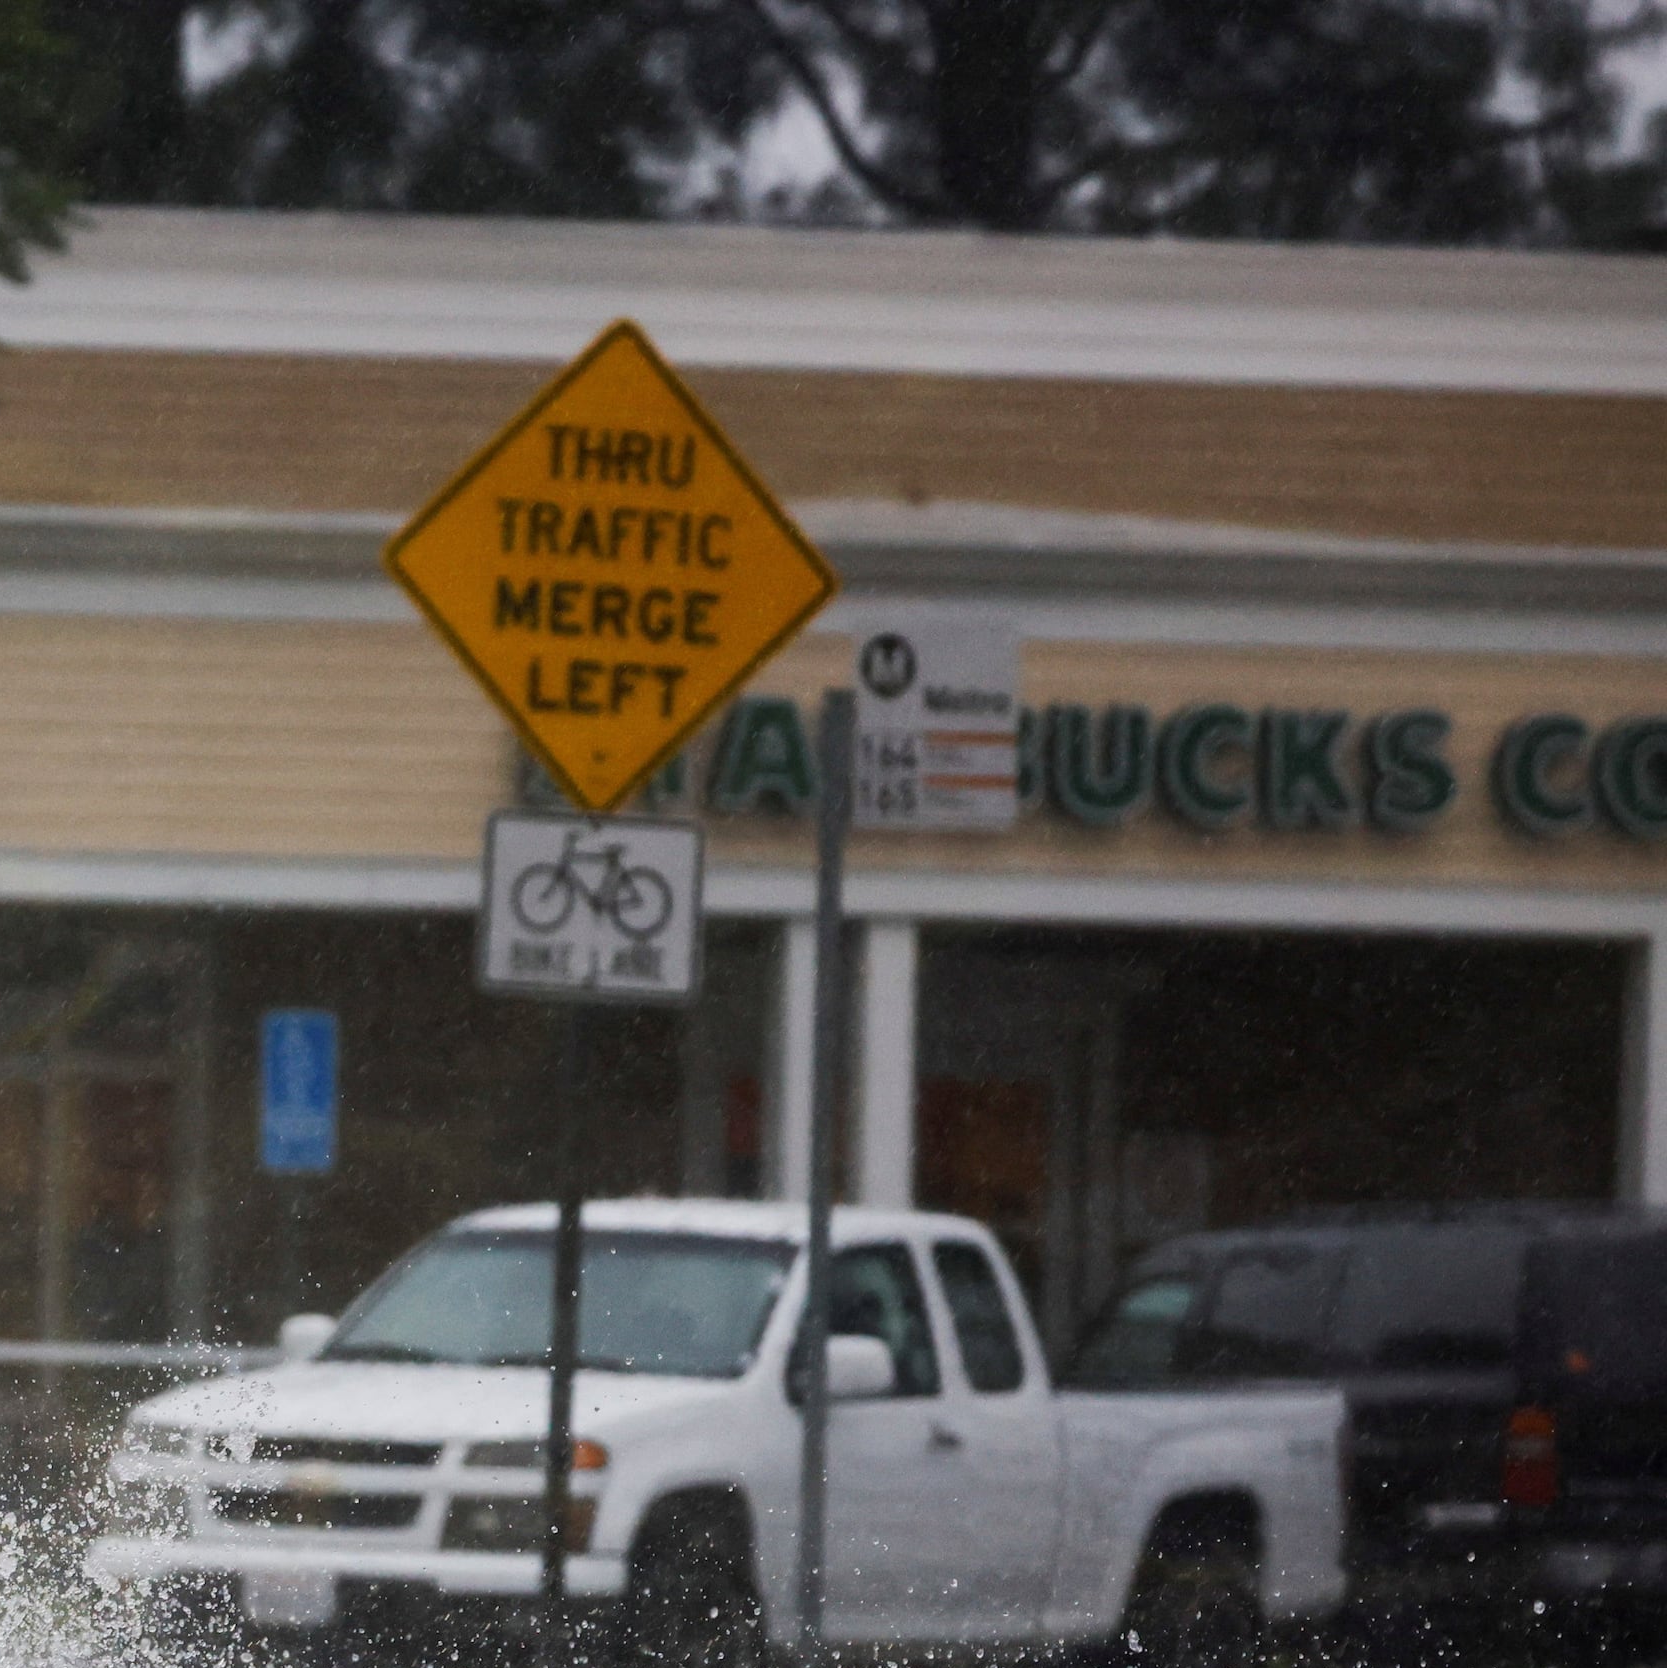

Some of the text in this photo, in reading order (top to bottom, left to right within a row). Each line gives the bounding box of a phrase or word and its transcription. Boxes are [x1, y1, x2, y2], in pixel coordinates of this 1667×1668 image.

[546, 423, 696, 490] THRU
[496, 498, 733, 570] TRAFFIC
[494, 576, 720, 646] MERGE
[527, 656, 688, 718] LEFT
